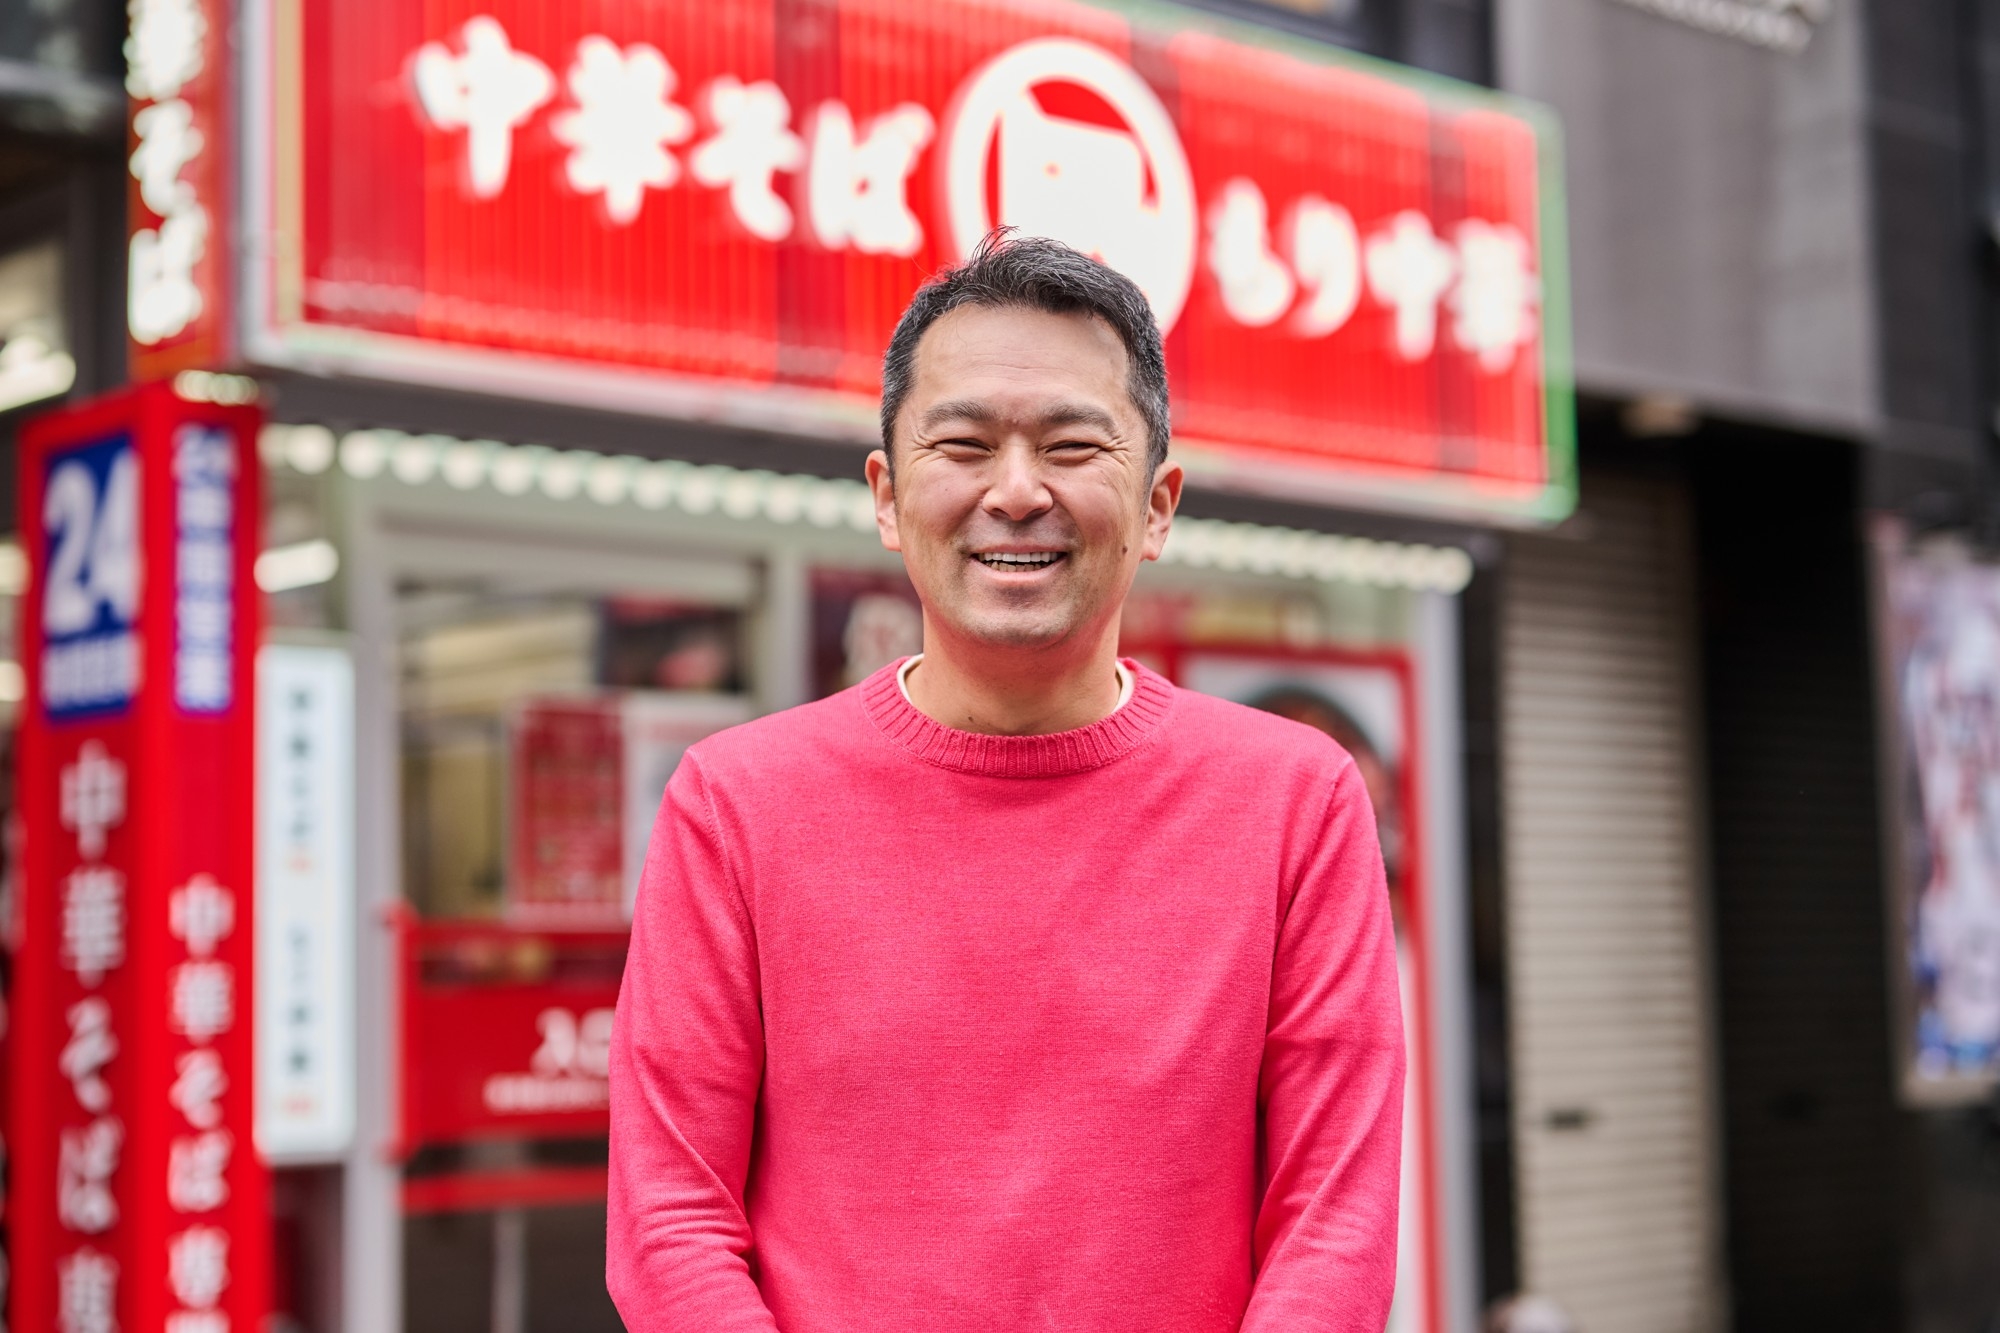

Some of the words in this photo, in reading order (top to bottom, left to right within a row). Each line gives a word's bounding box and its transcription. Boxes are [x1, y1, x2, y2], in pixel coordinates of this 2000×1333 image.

[411, 15, 934, 258] 中華そば
[1211, 178, 1536, 374] もり中華
[43, 448, 143, 636] 24
